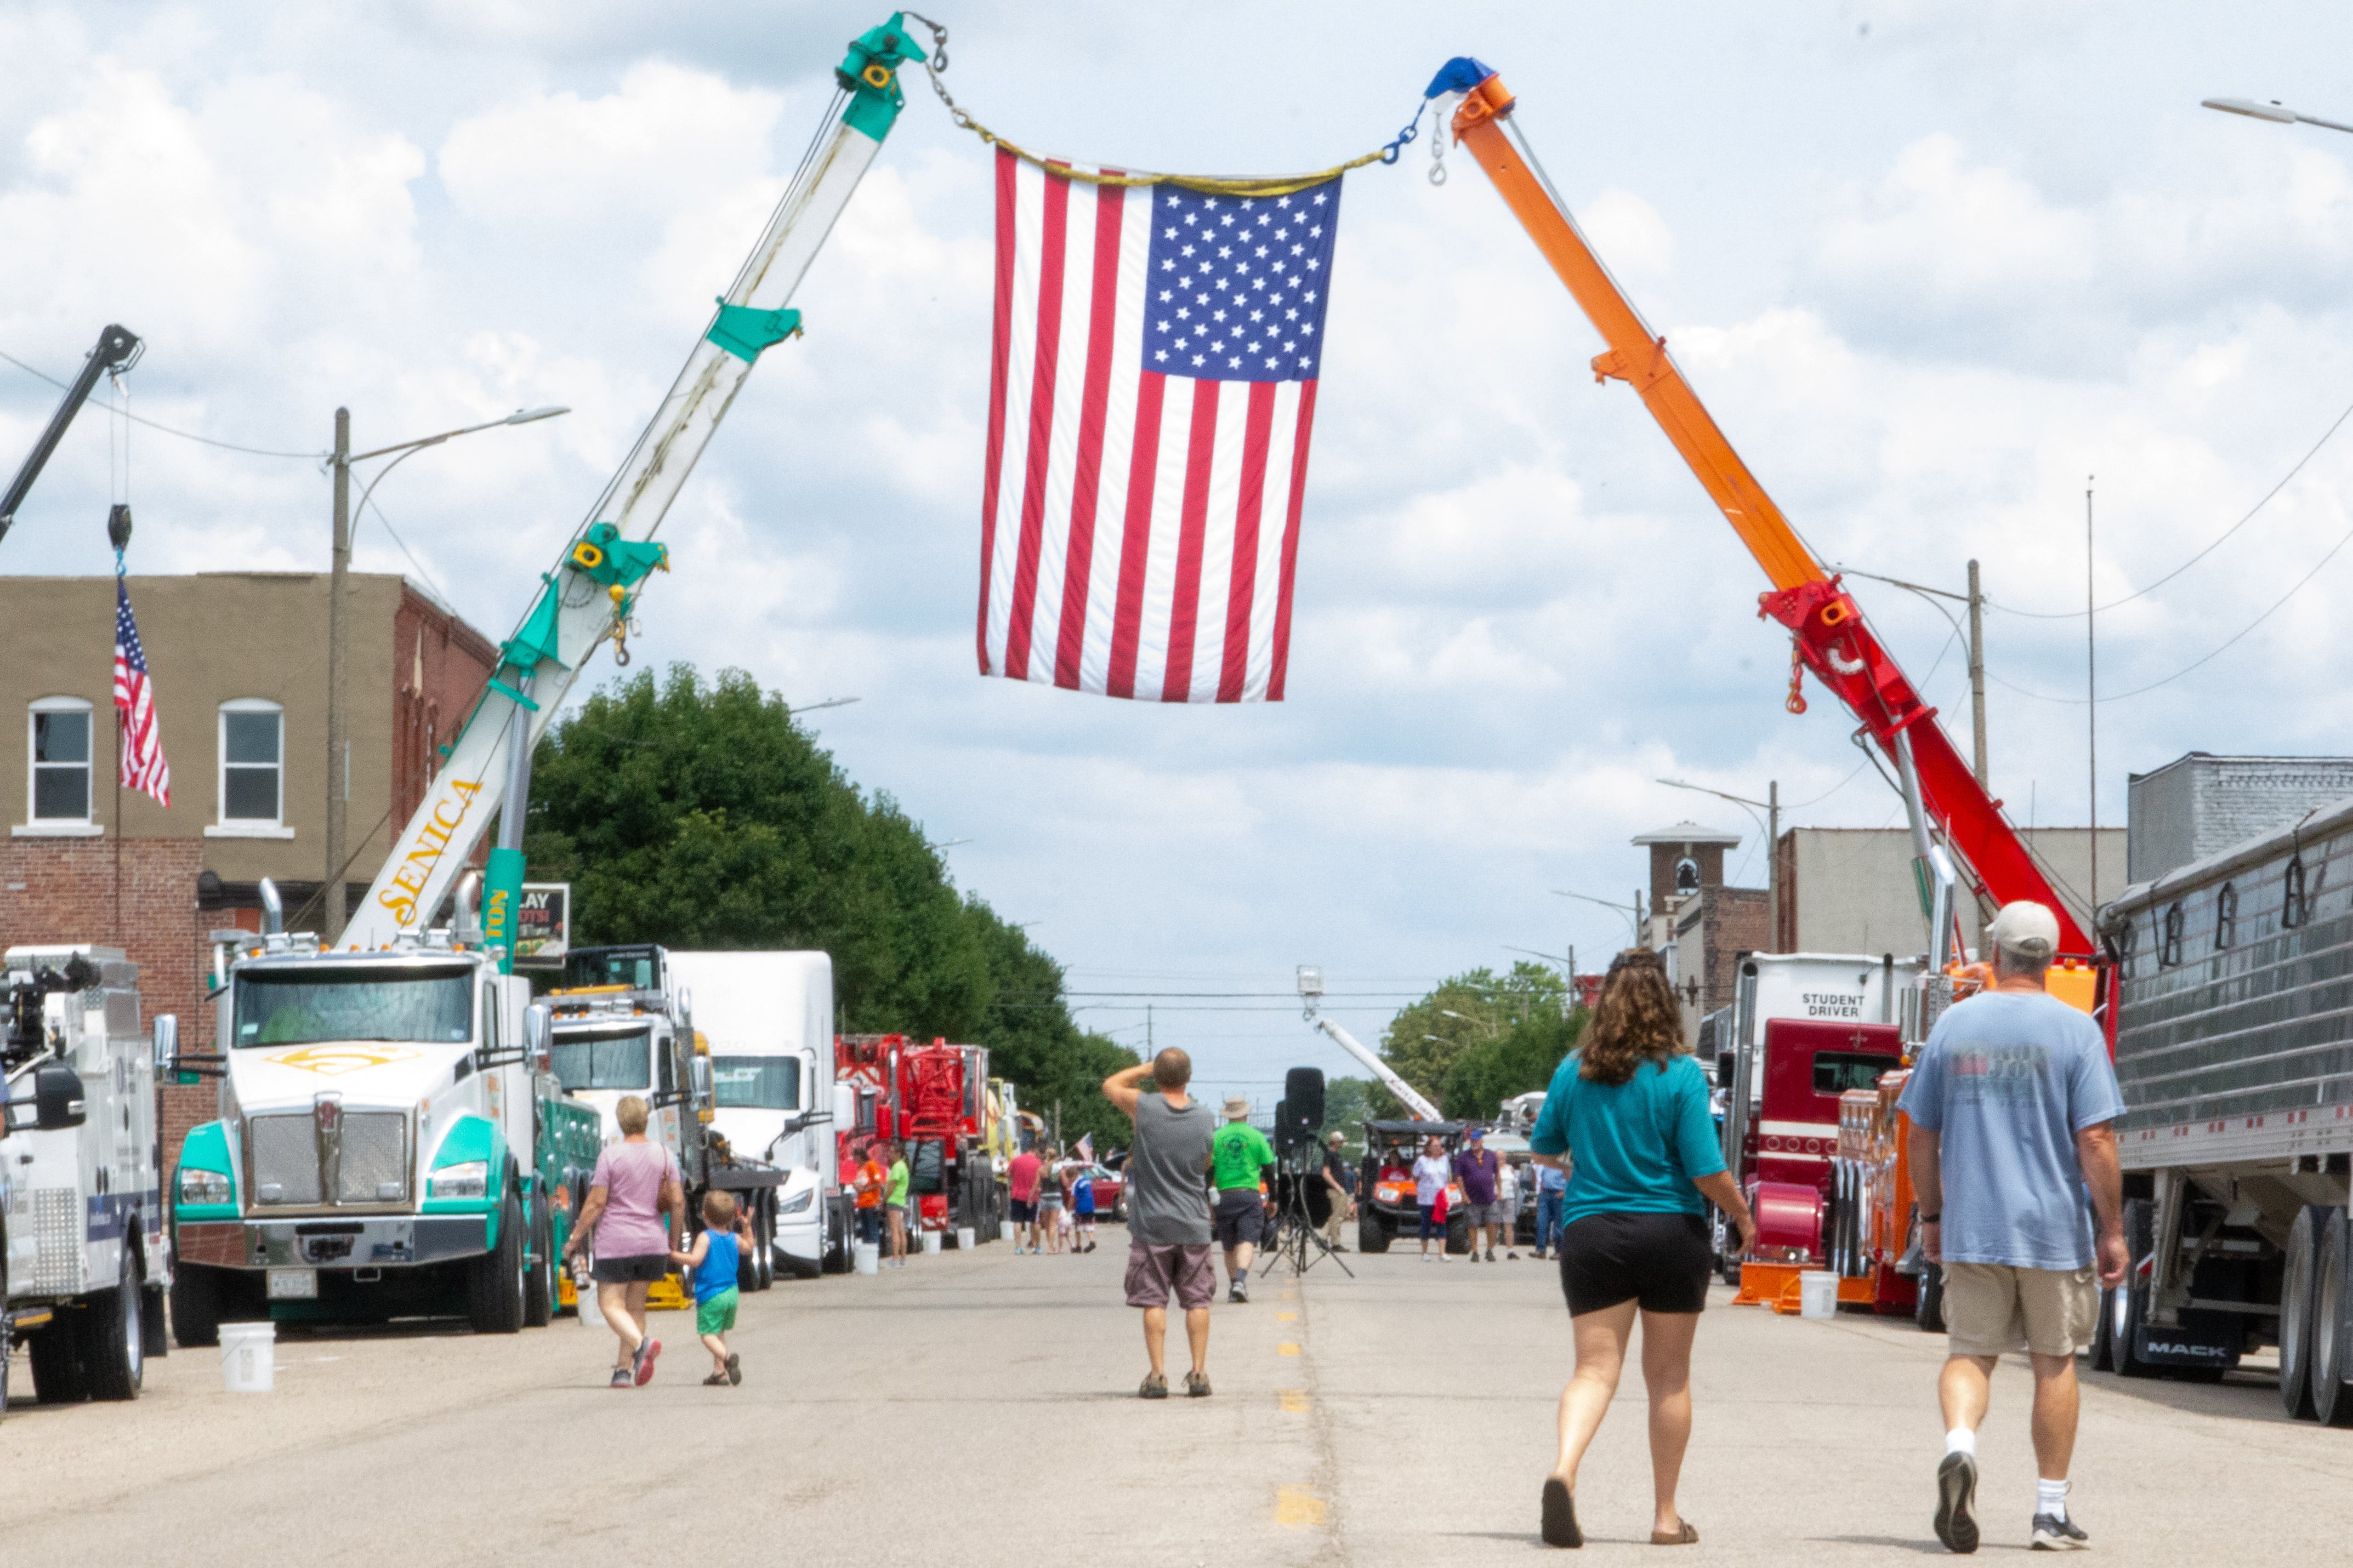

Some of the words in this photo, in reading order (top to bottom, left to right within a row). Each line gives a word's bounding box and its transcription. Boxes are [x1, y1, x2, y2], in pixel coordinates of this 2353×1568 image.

[378, 779, 484, 927] SENICA
[485, 890, 508, 939] TON
[1802, 993, 1865, 1006] STUDENT
[1809, 1006, 1858, 1017] DRIVER
[2148, 1342, 2226, 1358] MACK
